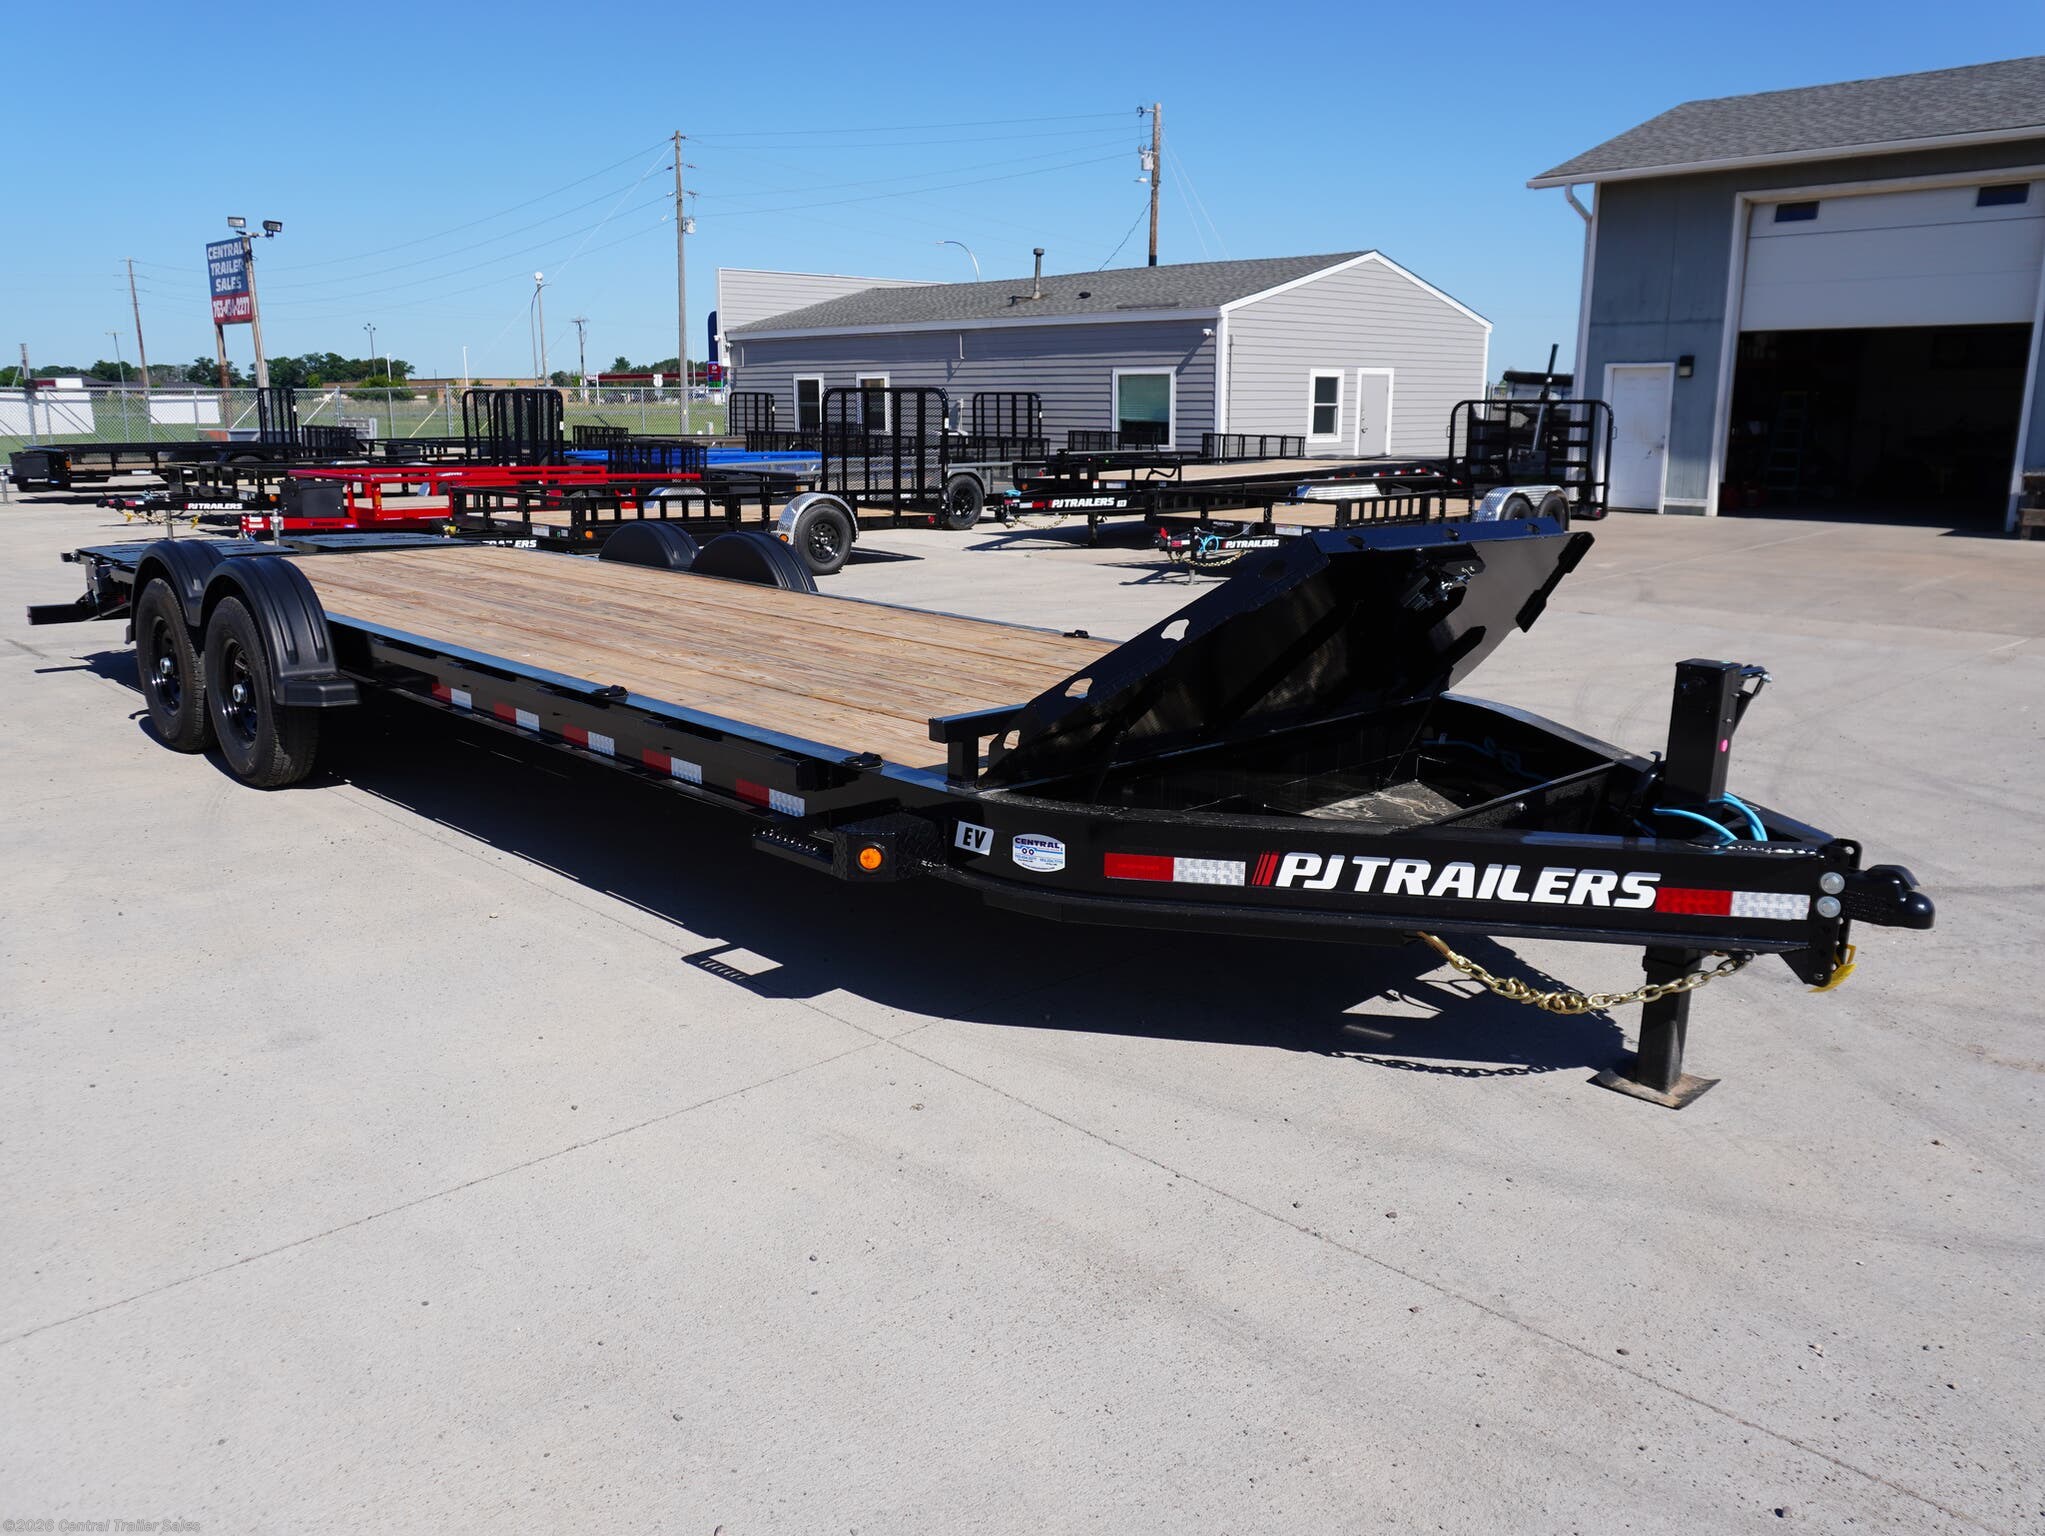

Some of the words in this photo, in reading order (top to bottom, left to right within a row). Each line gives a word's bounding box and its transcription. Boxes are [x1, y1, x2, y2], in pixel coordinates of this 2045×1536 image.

[208, 241, 243, 260] CENTRAL
[210, 259, 244, 276] TRAILER
[215, 276, 242, 292] SALES
[1052, 500, 1064, 508] PJ
[1064, 497, 1115, 507] TRAILERS
[1225, 540, 1237, 548] PJ
[1236, 539, 1279, 548] TRAILERS
[963, 826, 987, 849] EV
[1015, 837, 1060, 849] CENTRAL
[1275, 852, 1346, 890] PJ
[1352, 855, 1662, 909] TRAILERS
